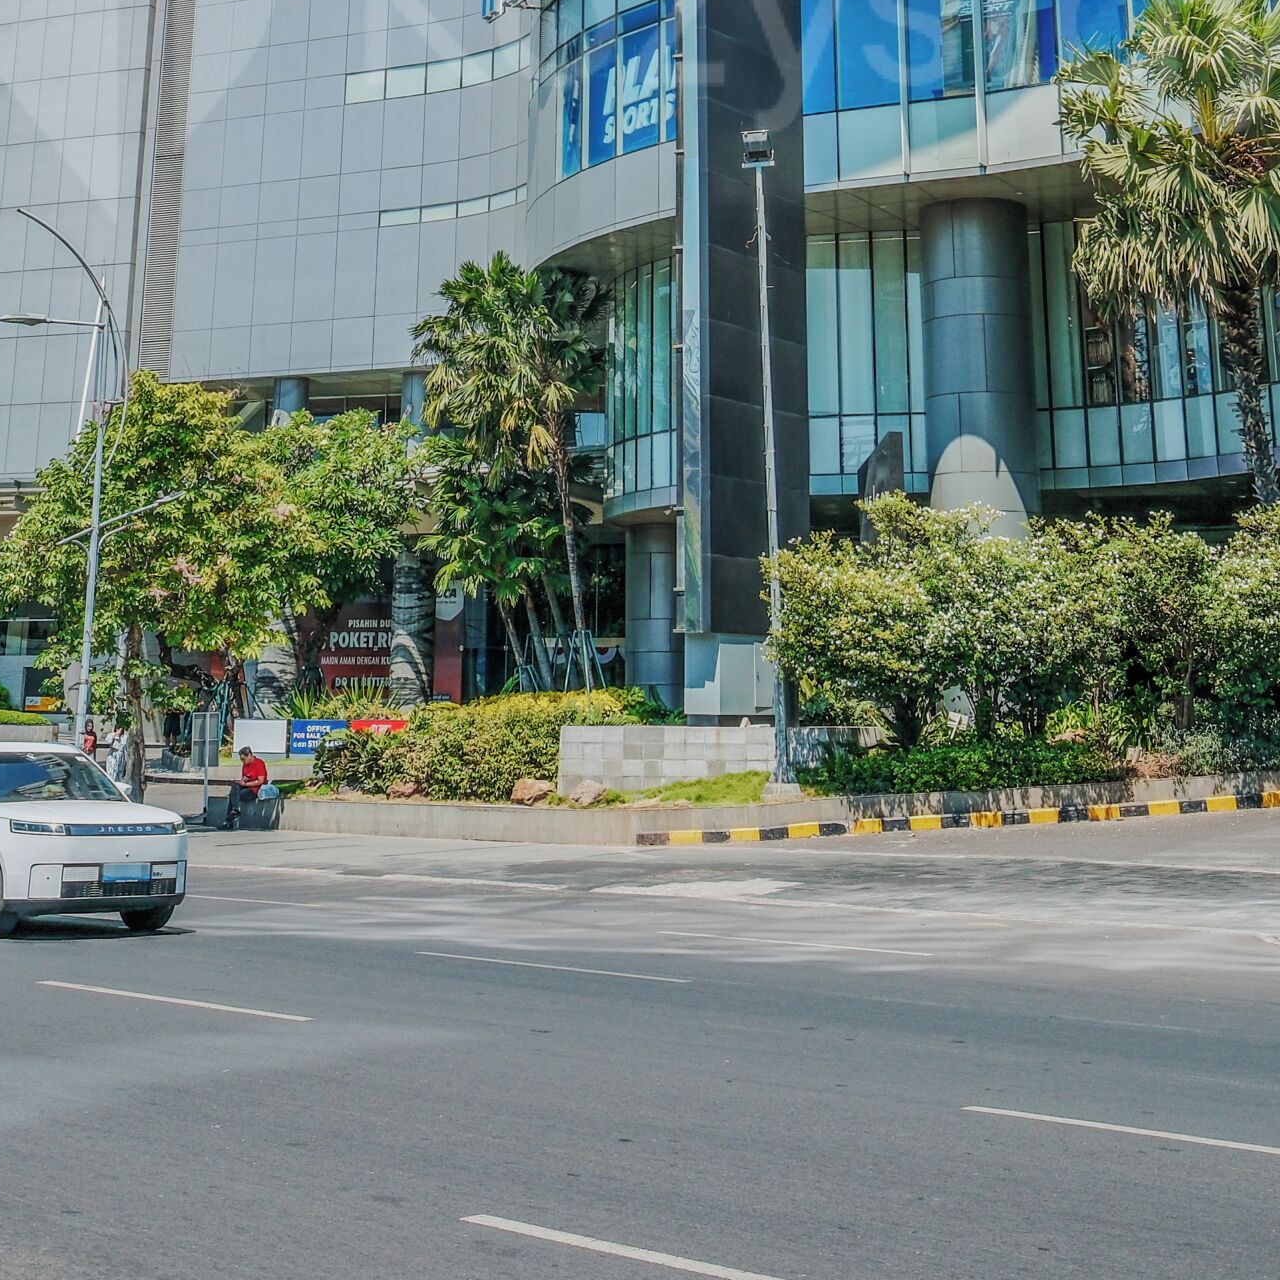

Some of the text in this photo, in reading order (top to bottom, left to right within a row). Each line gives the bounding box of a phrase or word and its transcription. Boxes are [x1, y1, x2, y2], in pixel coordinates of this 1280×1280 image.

[958, 0, 1014, 16] SORT
[602, 92, 677, 144] SORTS
[348, 619, 378, 628] PISAHIN
[339, 656, 356, 665] AMAN
[356, 656, 380, 665] DENGAN
[306, 725, 331, 733] OFFICE
